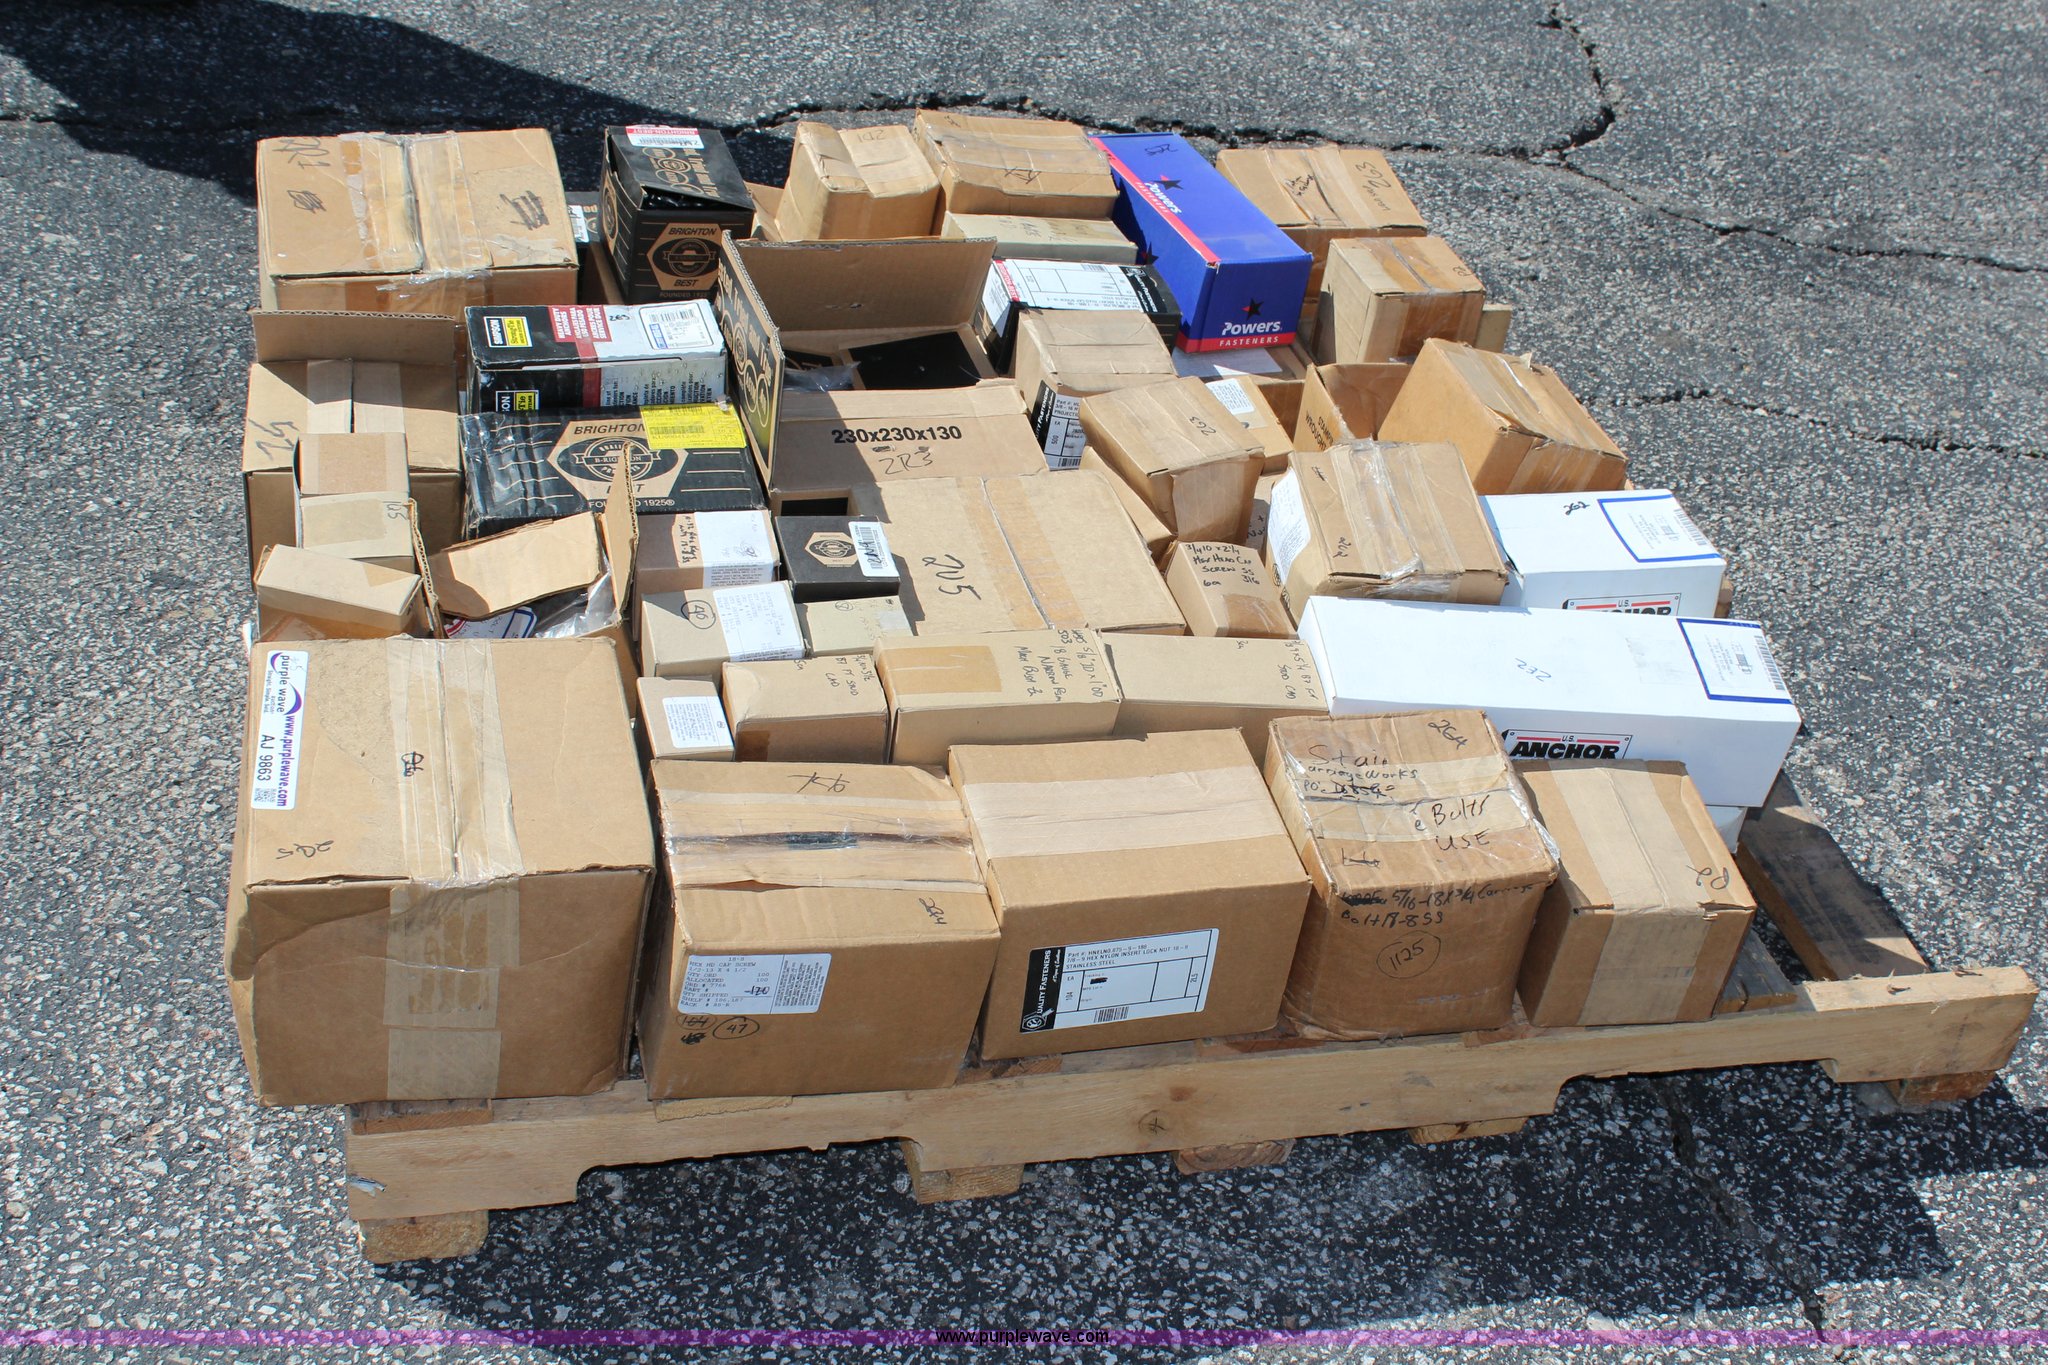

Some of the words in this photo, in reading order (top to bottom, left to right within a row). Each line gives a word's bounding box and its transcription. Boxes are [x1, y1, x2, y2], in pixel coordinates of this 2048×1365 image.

[1144, 181, 1182, 214] Powers
[668, 227, 717, 236] BRIGHTON
[674, 279, 699, 287] BEST
[489, 319, 503, 345] SIMPSON
[1221, 321, 1281, 336] Powers
[1219, 336, 1279, 347] FASTENERS
[832, 426, 962, 444] 230x230x130
[279, 655, 290, 685] purple
[277, 688, 287, 712] wave
[260, 735, 275, 749] AJ
[1509, 741, 1619, 759] ANCHOR
[257, 755, 273, 781] 9863
[277, 715, 295, 806] www.purplewave.com
[1435, 828, 1491, 851] USE
[1100, 951, 1120, 960] NYLON
[1389, 938, 1425, 971] 1125
[1039, 949, 1051, 990] FASTENERS
[1066, 961, 1097, 969] STAINLESS
[1099, 959, 1116, 967] STEEL
[726, 1023, 748, 1034] 47
